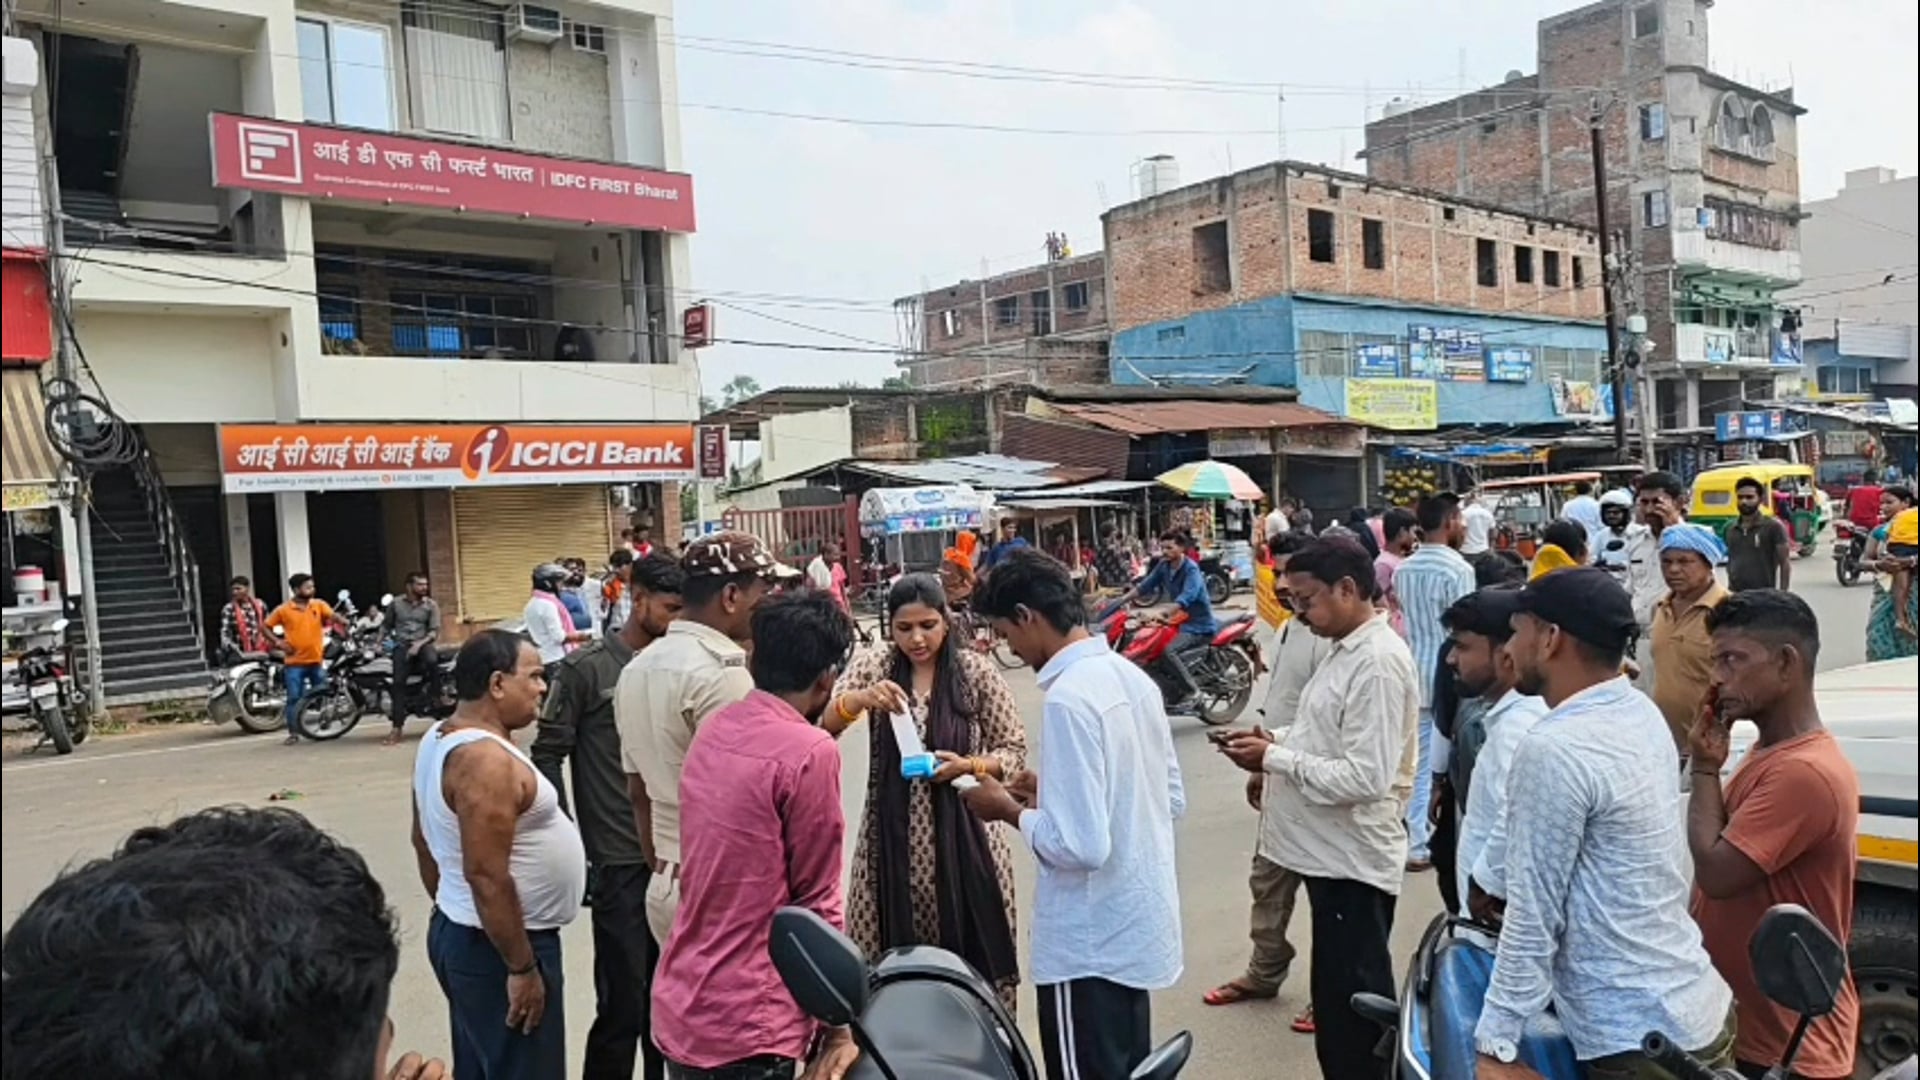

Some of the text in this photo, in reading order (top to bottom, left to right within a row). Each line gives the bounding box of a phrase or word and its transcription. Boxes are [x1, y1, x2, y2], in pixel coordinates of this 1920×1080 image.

[313, 140, 534, 182] आई डी एफ सी फर्स्ट भारत
[550, 171, 679, 200] IDFC FIRST Bharat
[237, 434, 453, 470] आई सी आई सी आई बैंक
[511, 440, 684, 466] ICICI Bank
